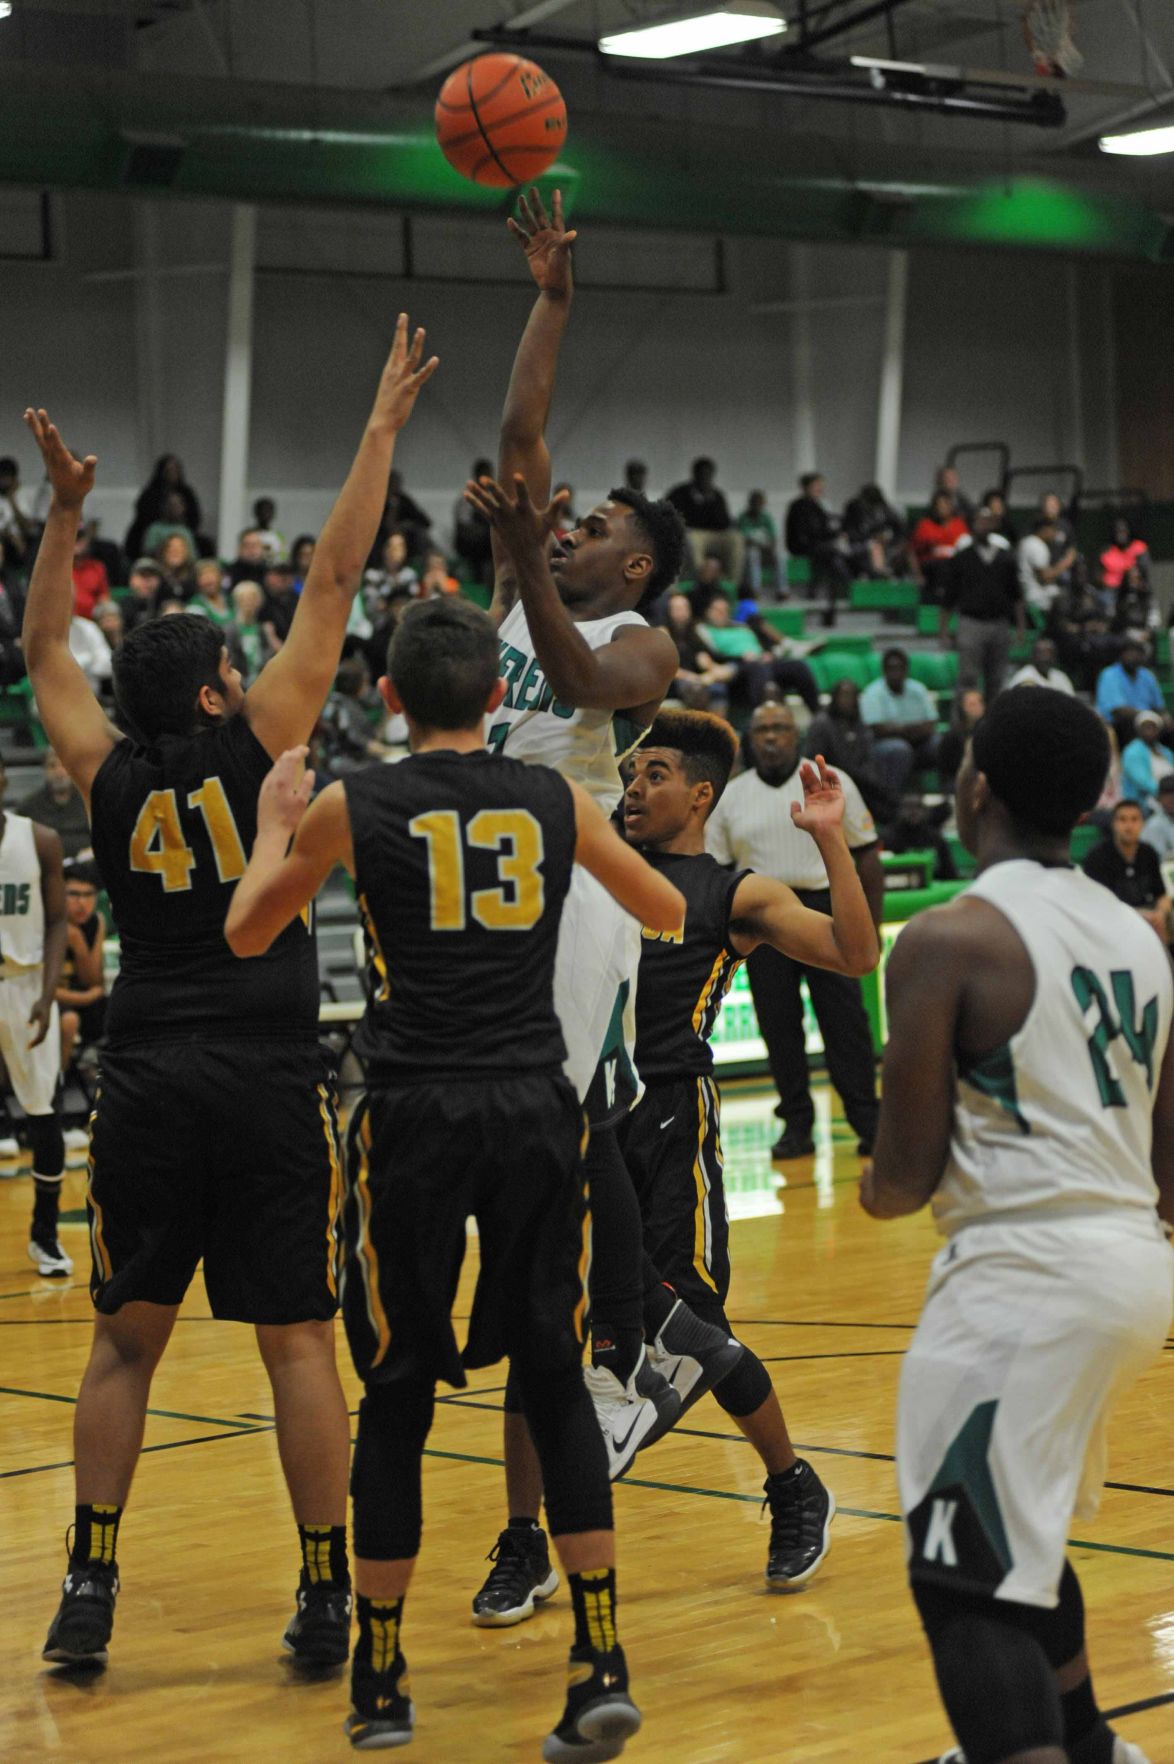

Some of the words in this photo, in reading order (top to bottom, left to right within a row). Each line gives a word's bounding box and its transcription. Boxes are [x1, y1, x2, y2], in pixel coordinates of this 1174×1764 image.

[129, 775, 248, 893] 41
[408, 808, 545, 931] 13
[1071, 966, 1159, 1109] 24
[923, 1499, 958, 1566] K
